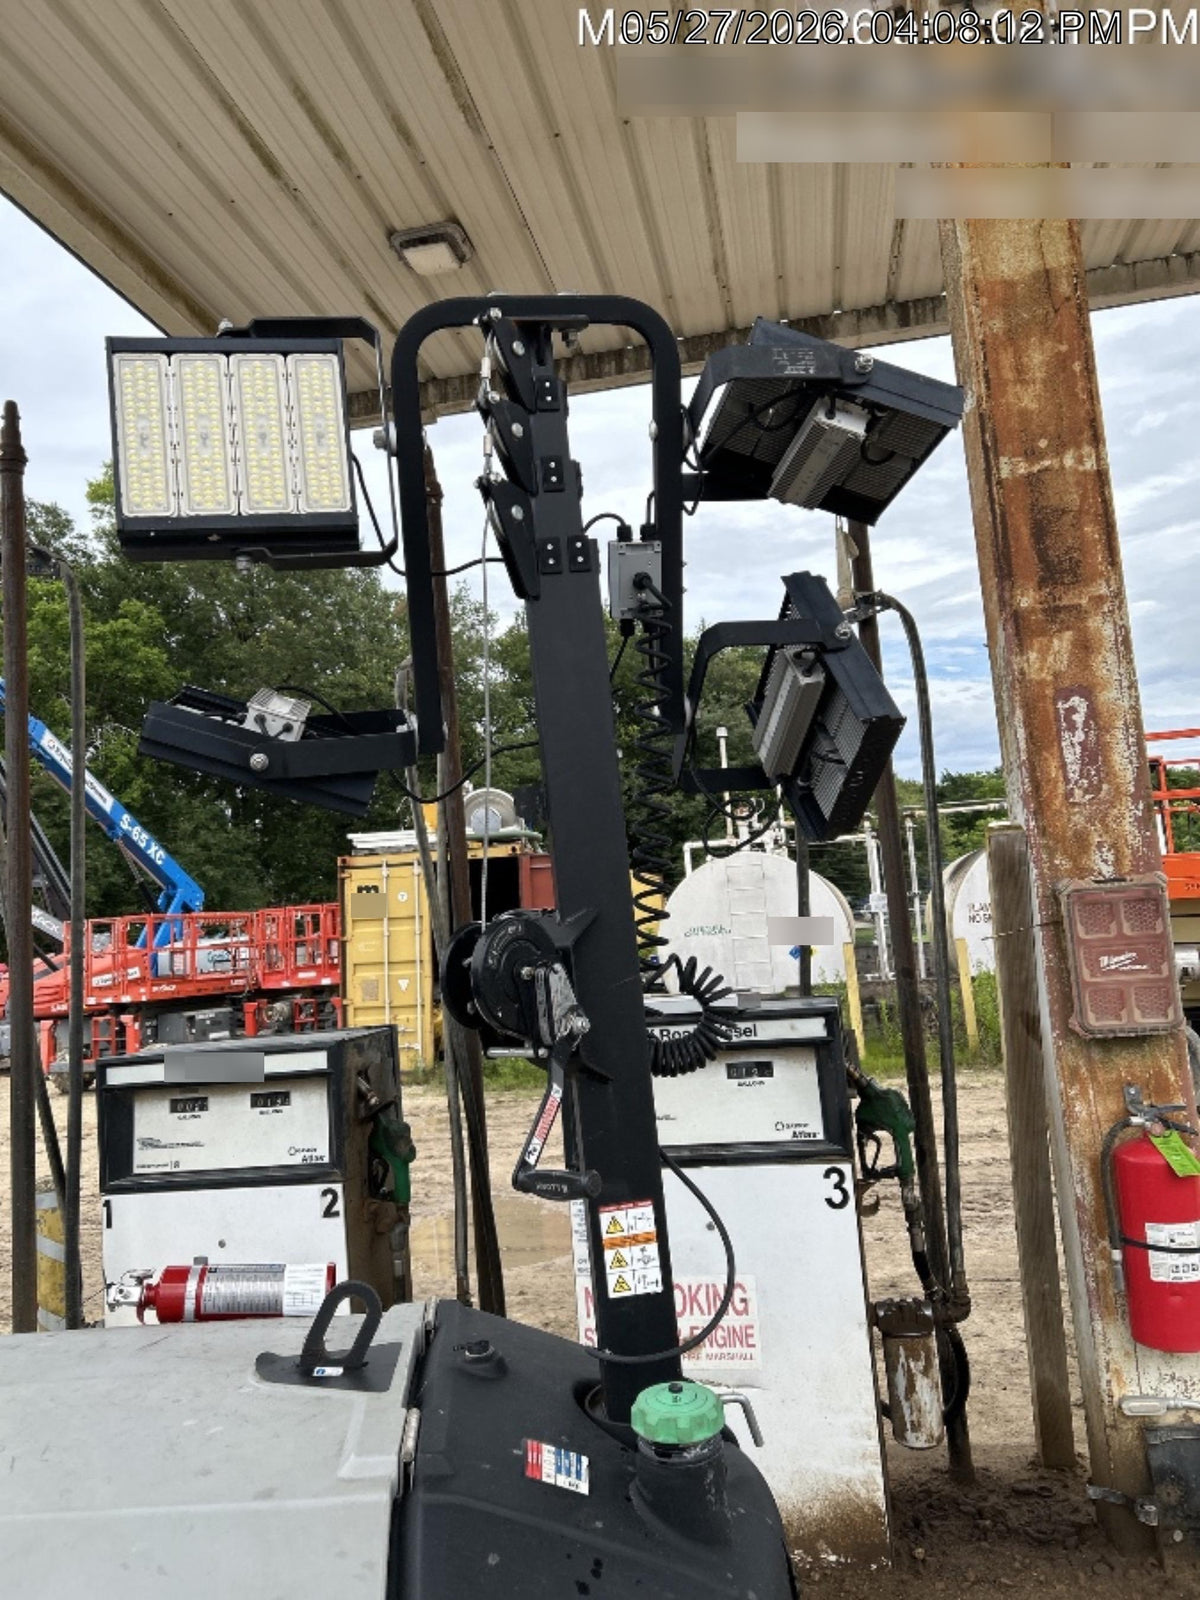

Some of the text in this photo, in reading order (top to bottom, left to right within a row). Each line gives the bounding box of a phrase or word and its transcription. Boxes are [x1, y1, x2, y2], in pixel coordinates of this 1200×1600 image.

[321, 1187, 340, 1218] 2
[823, 1166, 850, 1209] 3
[102, 1199, 112, 1229] 1
